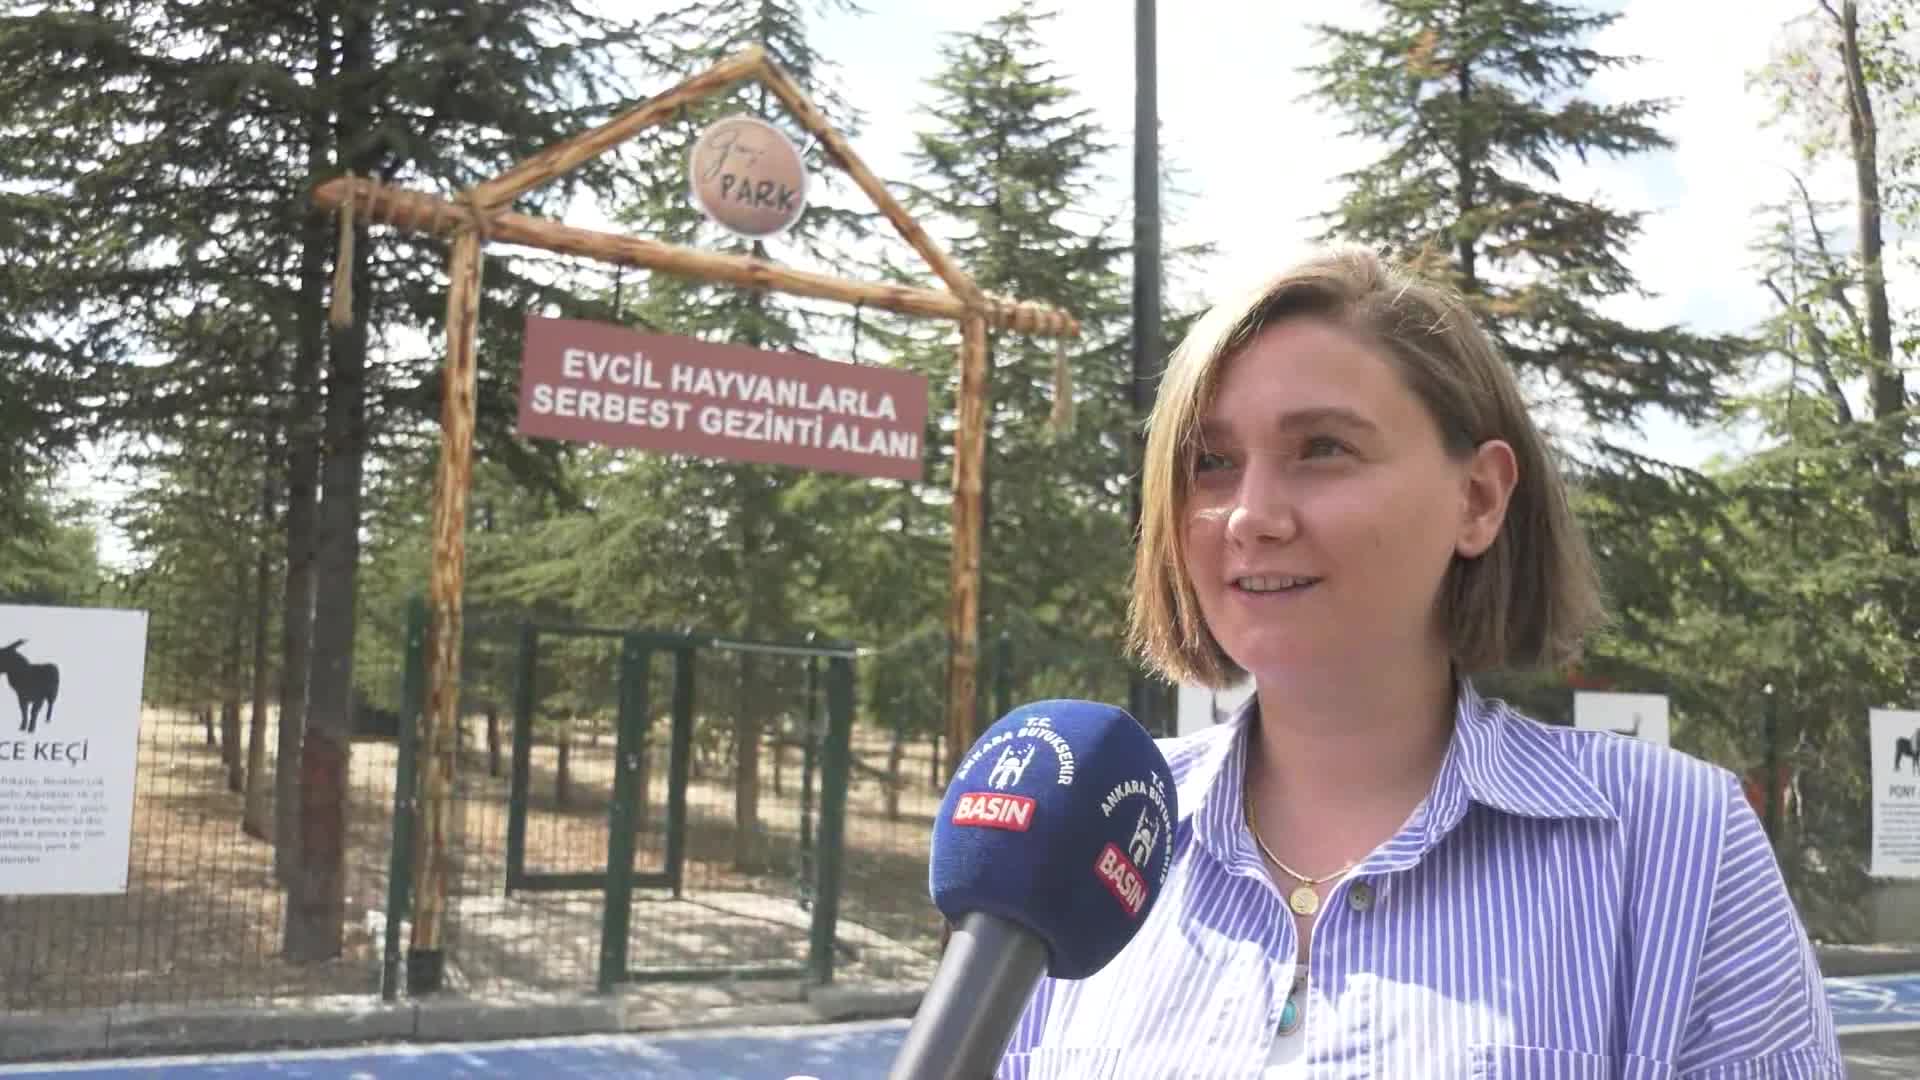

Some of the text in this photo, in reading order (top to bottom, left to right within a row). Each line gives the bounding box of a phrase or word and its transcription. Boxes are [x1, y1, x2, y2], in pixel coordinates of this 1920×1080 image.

[721, 173, 795, 210] PARK
[563, 348, 898, 422] EVCİL HAYVANLARLA
[531, 383, 919, 460] SERBEST GEZİNTİ ALANI
[33, 738, 88, 768] KEÇİ
[958, 731, 1013, 780] ANKARA
[955, 796, 1031, 825] BASIN
[1101, 780, 1147, 817] ANKARA
[1100, 848, 1147, 913] BASIN
